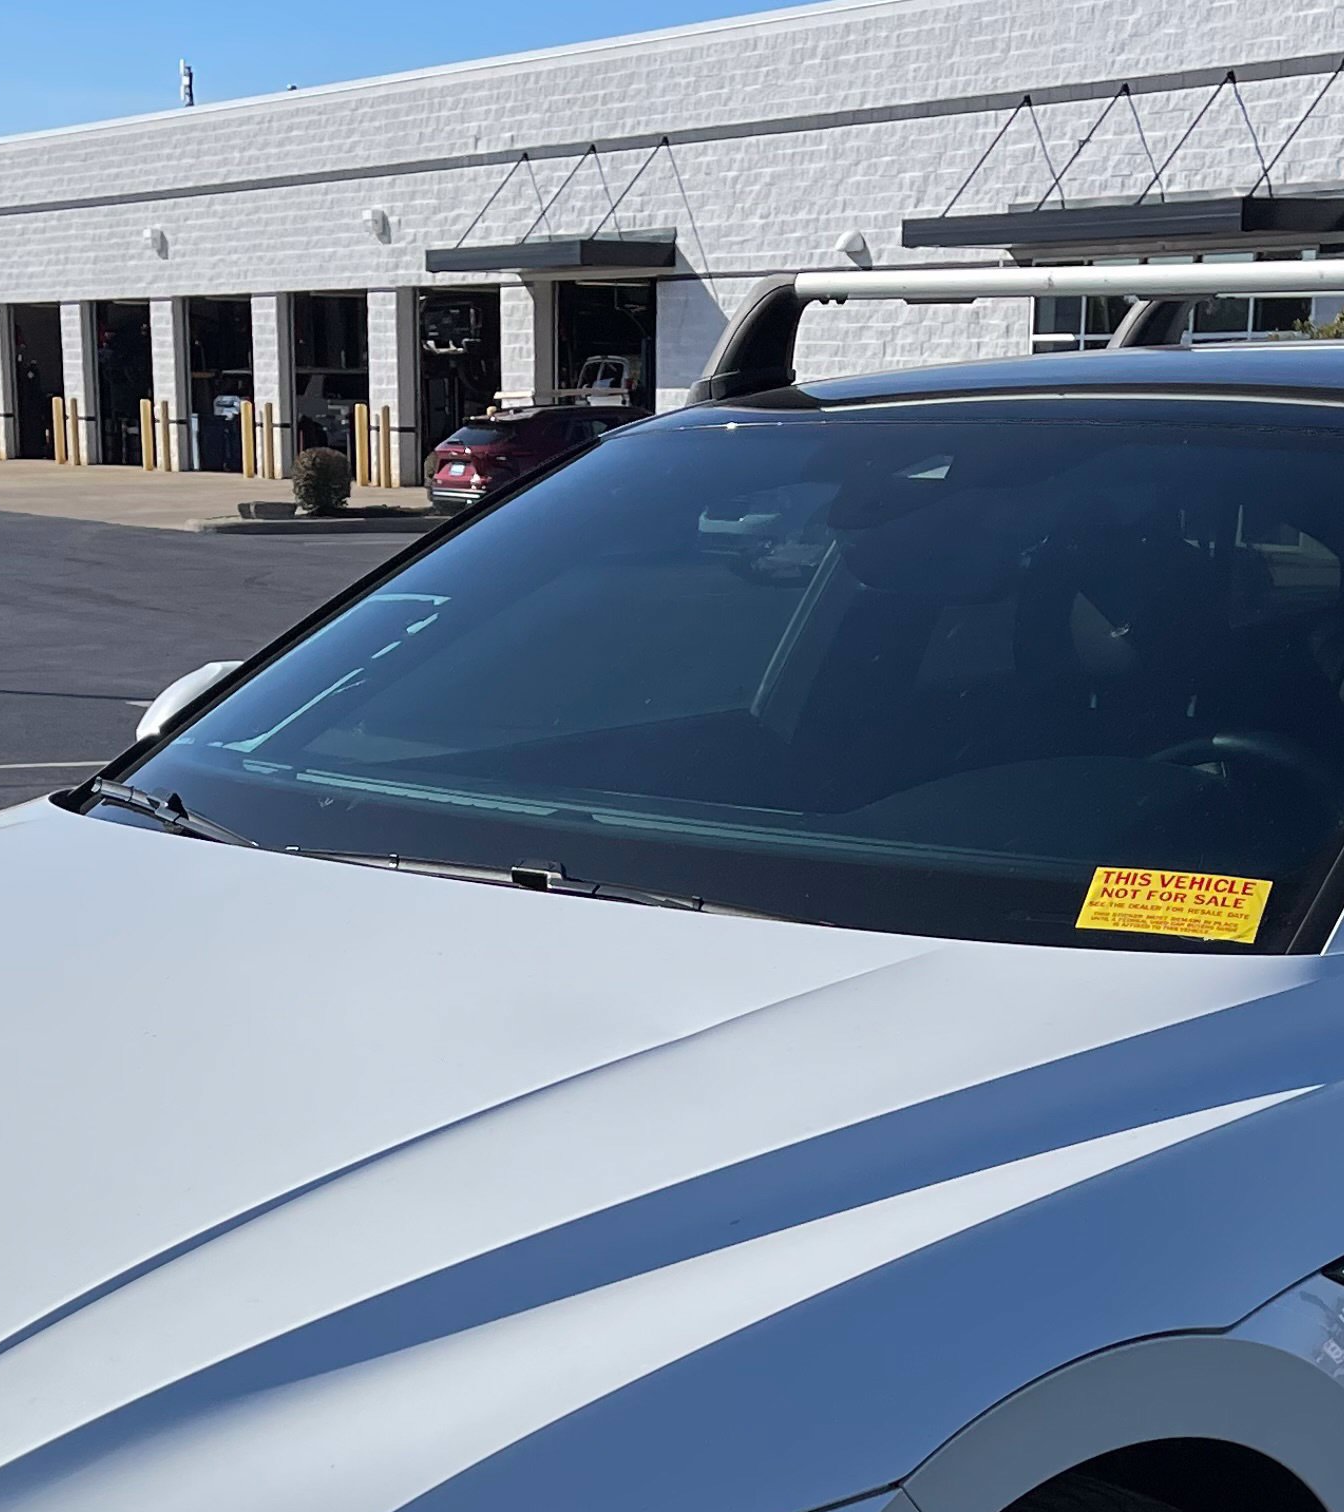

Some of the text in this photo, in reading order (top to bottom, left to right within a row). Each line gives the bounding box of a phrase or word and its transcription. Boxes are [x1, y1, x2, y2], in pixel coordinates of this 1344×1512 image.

[1103, 871, 1257, 897] THIS VEHICLE
[1100, 887, 1247, 909] NOT FOR SALE
[1128, 903, 1162, 911] DEALER
[1166, 905, 1184, 913] FOR
[1188, 908, 1223, 917] RESALE
[1227, 911, 1250, 920] DATE
